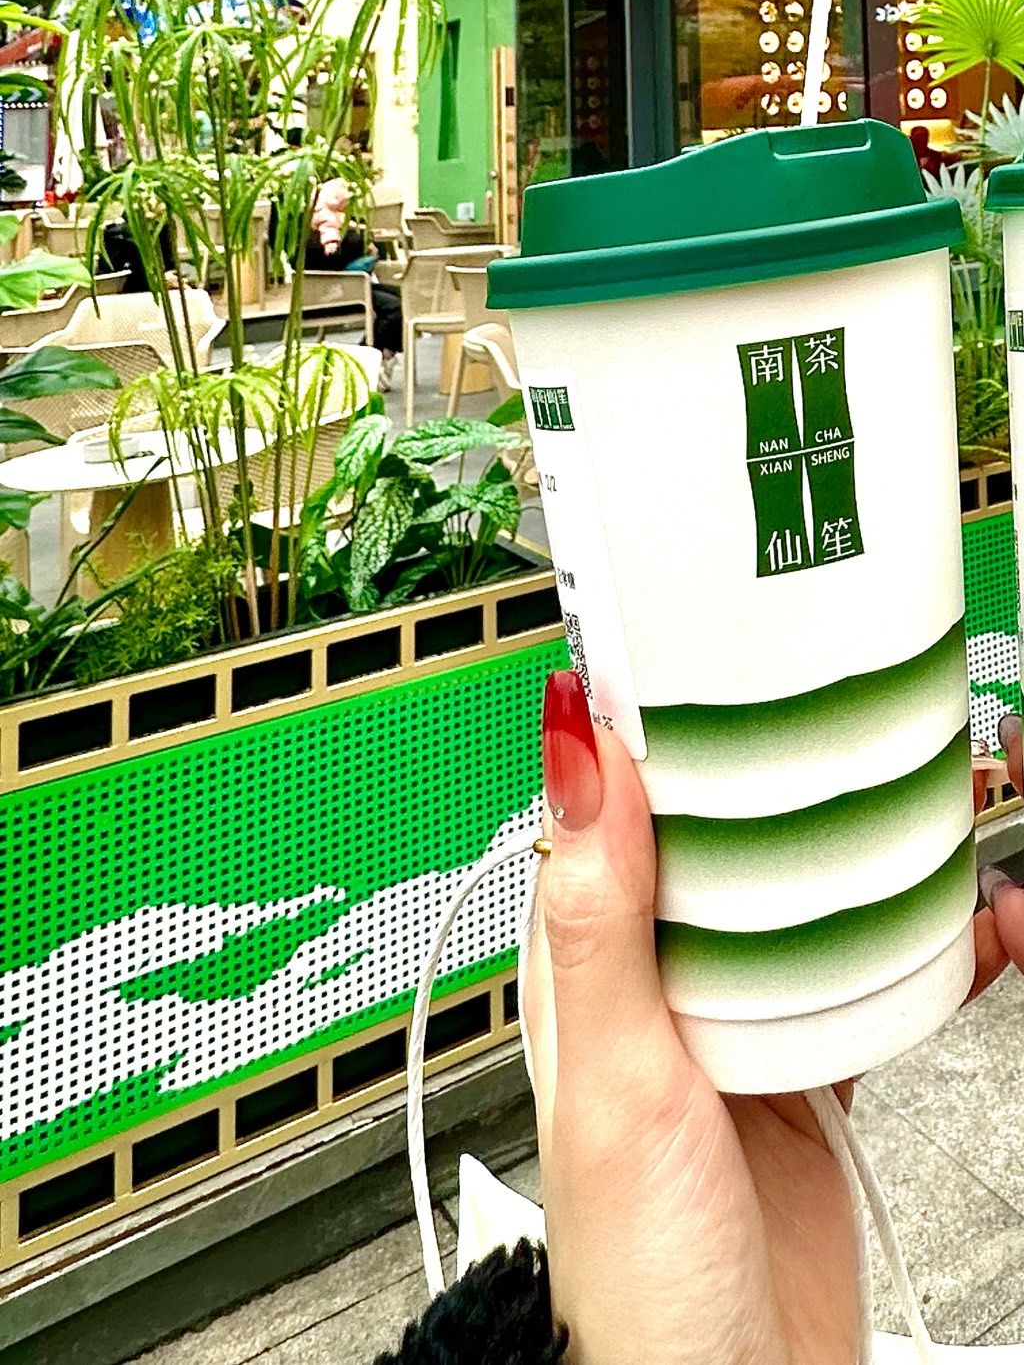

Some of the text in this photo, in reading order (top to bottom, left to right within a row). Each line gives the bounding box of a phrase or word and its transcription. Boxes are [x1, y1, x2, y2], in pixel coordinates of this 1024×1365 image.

[748, 334, 839, 386] 南茶
[760, 427, 842, 454] NAN CHA
[760, 446, 850, 475] XIAN SHENG
[765, 517, 856, 572] 仙笙
